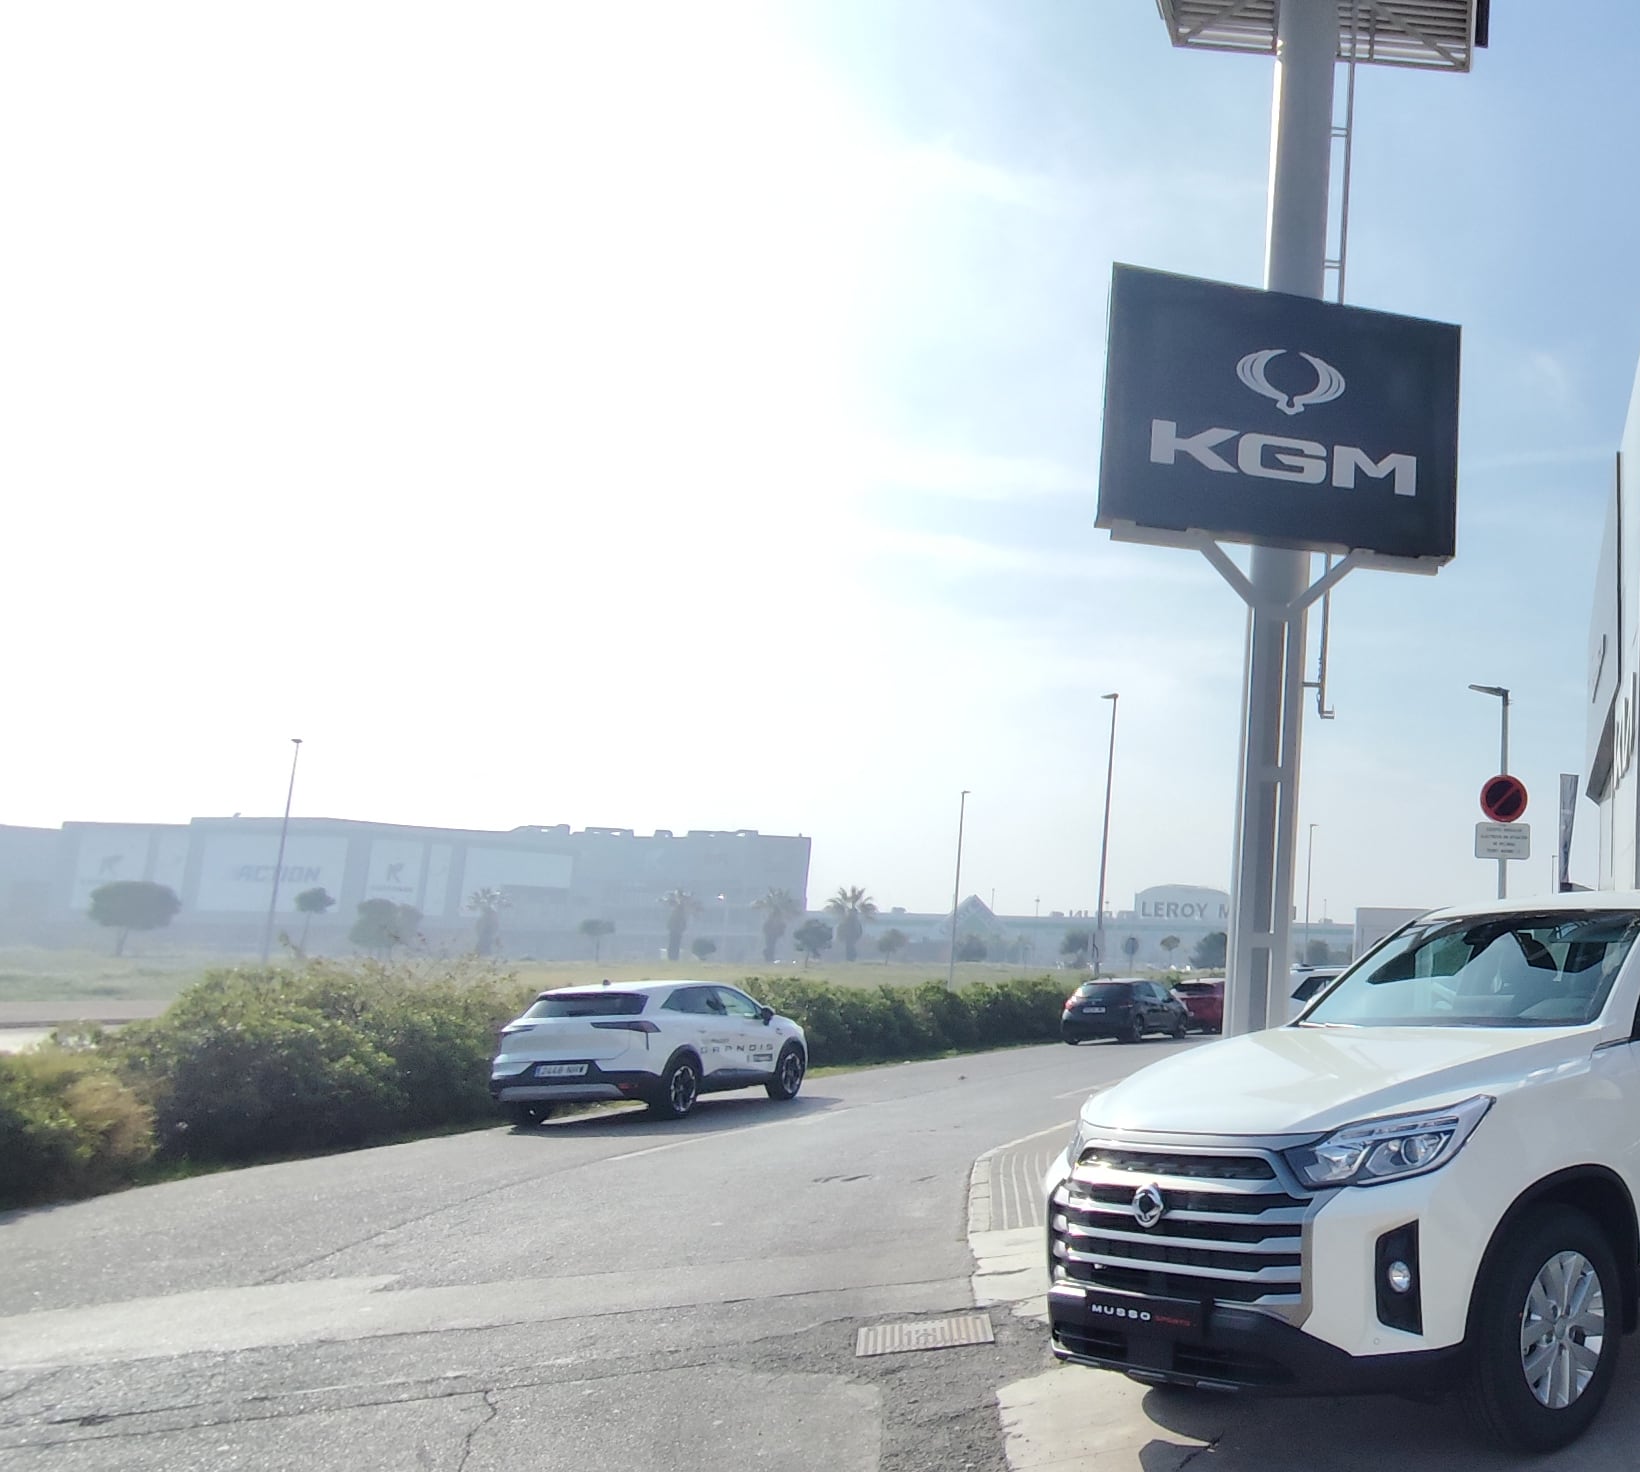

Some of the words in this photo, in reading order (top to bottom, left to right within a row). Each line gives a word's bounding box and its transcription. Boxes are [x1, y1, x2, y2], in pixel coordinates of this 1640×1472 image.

[1149, 418, 1417, 497] KGM
[237, 864, 321, 882] ACTION
[1140, 901, 1208, 918] LEROY
[1091, 1304, 1151, 1321] MUSSO
